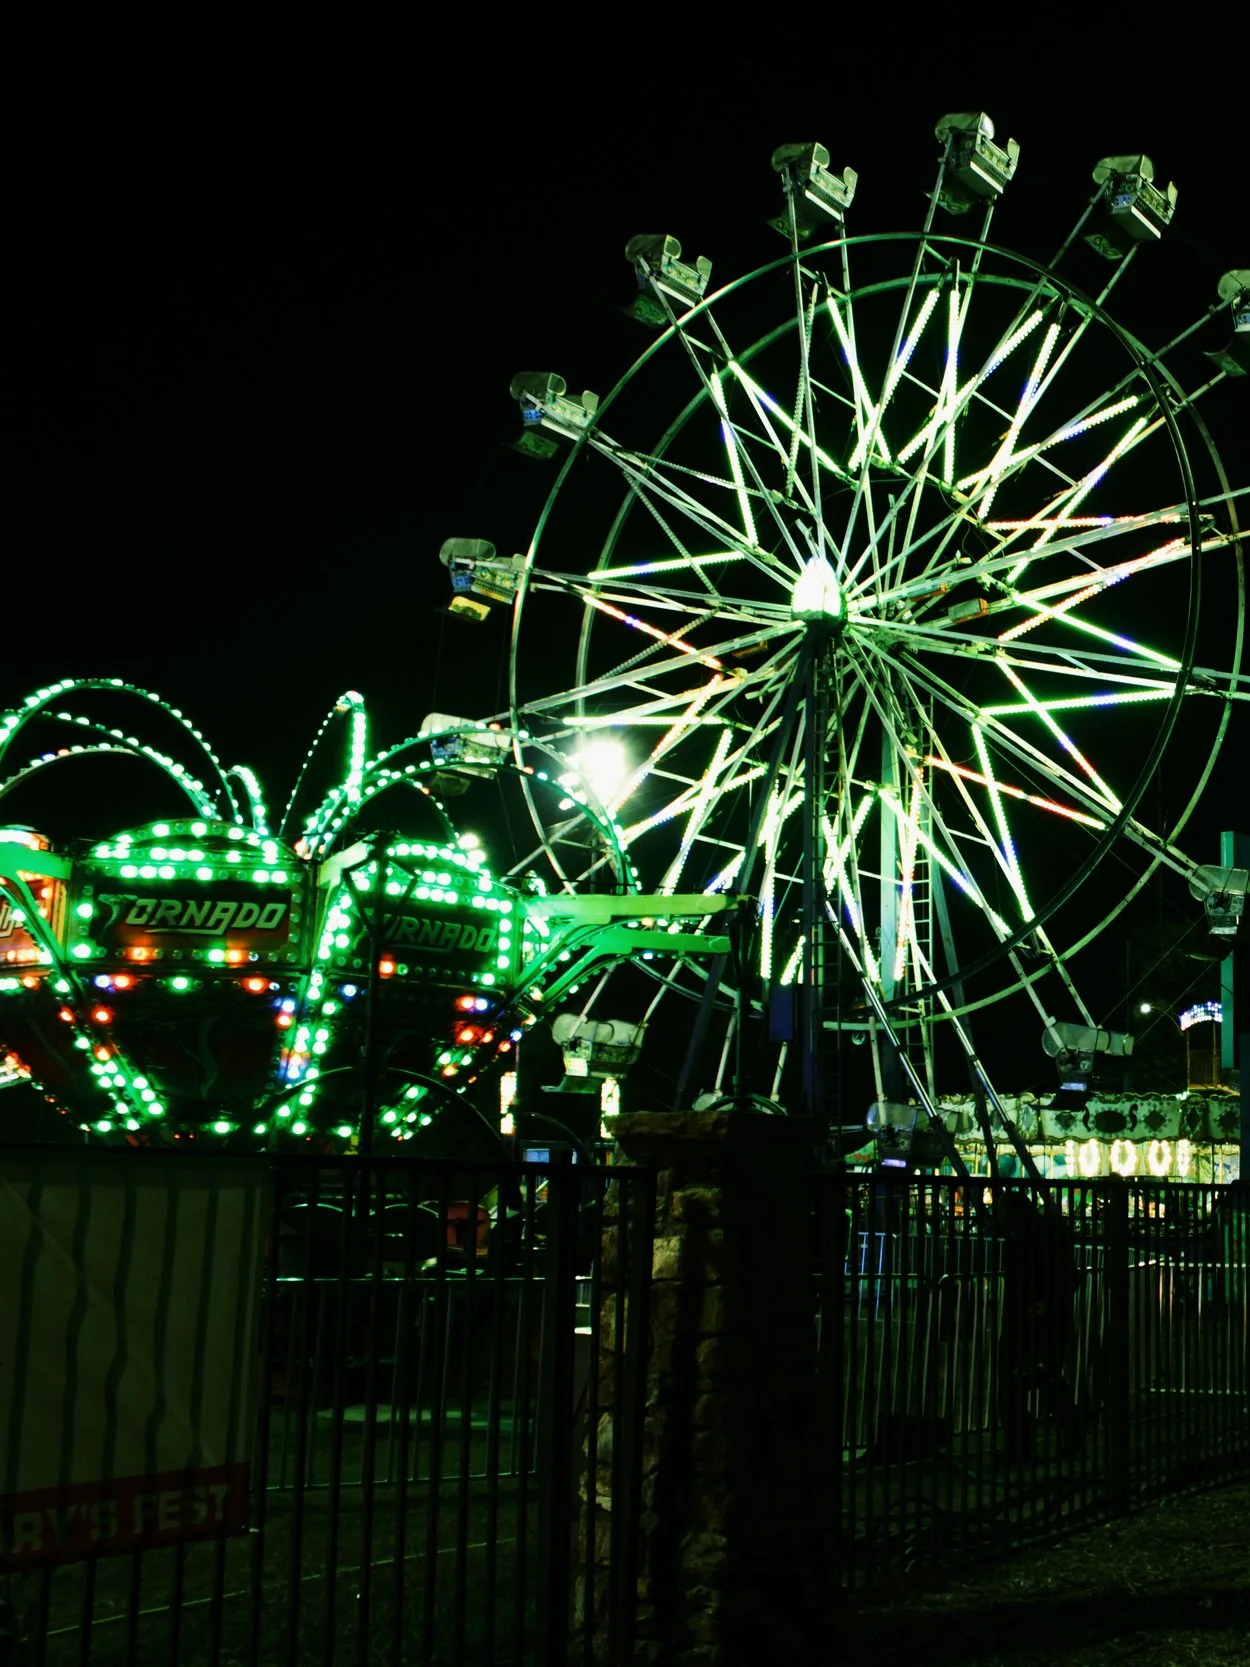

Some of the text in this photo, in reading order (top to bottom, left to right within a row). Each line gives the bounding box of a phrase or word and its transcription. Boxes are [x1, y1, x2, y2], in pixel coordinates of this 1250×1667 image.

[98, 893, 287, 940] TORNADO
[0, 1484, 231, 1555] RY'S FEST
